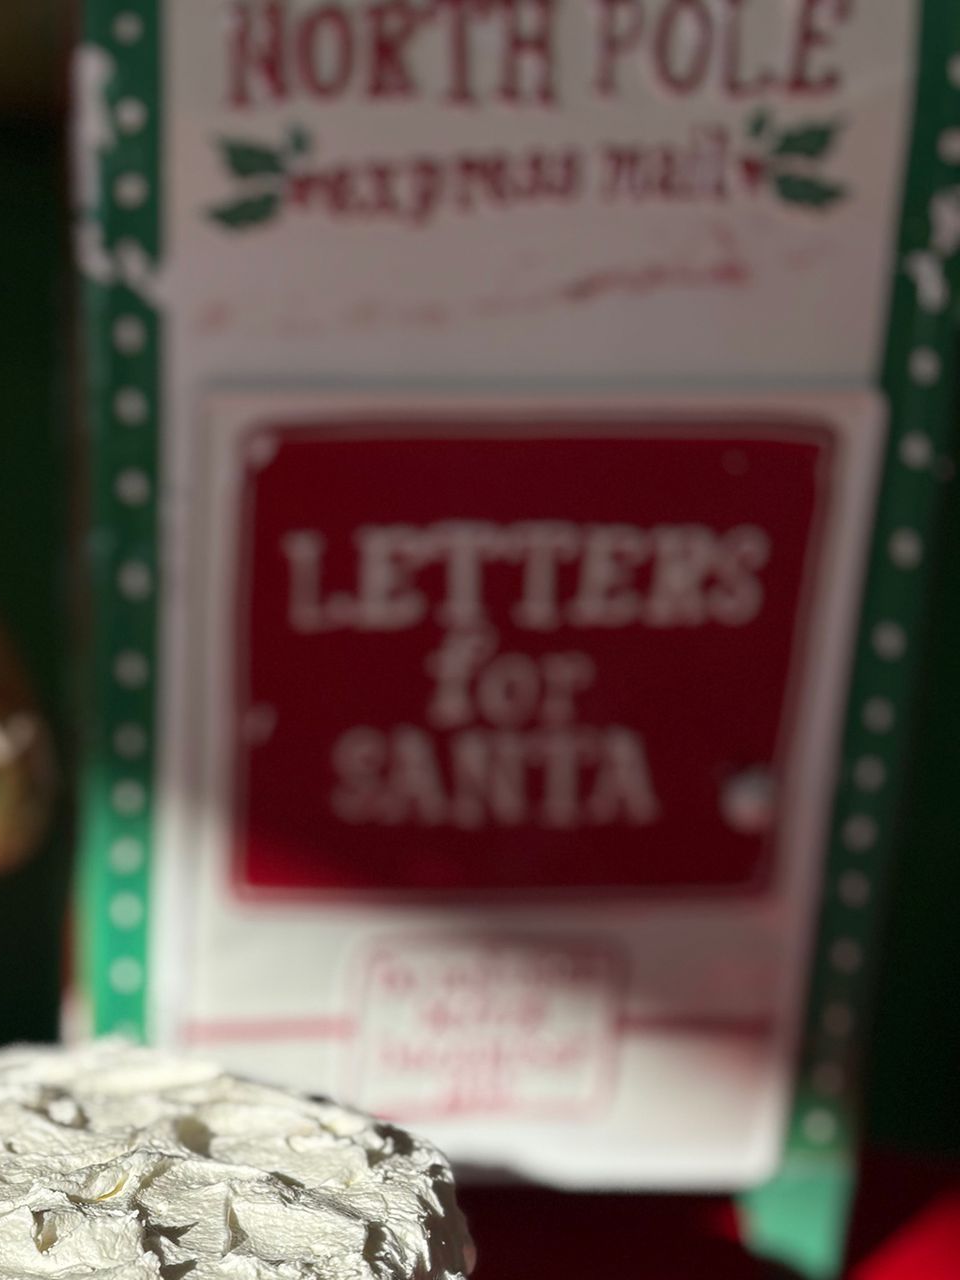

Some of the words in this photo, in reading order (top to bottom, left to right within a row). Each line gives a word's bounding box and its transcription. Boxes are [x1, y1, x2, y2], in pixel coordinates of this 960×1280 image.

[226, 0, 564, 107] NORTH
[594, 0, 852, 98] POLE
[281, 519, 771, 633] LETTERS
[425, 620, 596, 729] for
[330, 724, 660, 830] SANTA
